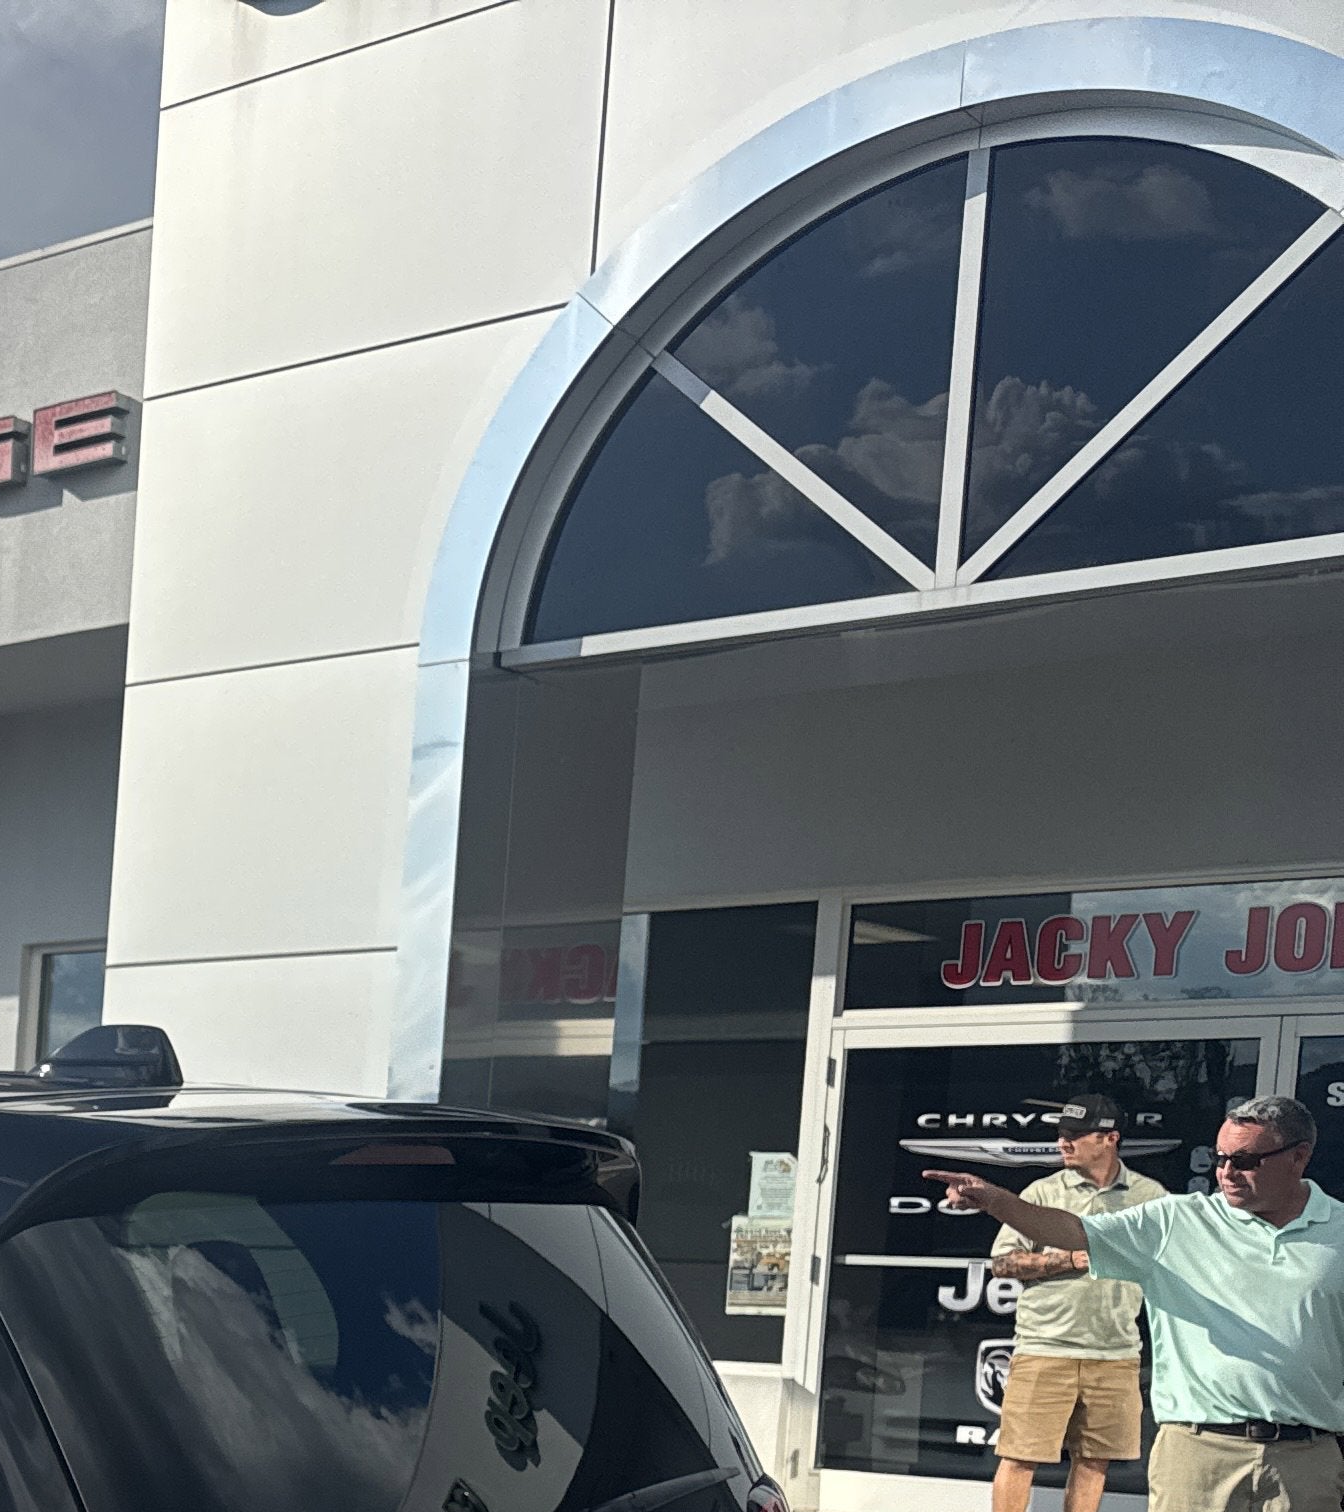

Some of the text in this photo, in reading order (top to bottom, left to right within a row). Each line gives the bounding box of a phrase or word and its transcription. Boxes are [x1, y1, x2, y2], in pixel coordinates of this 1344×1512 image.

[941, 901, 1344, 989] JACKY JO
[916, 1111, 1163, 1130] CHRYSR
[938, 1261, 1024, 1315] Je
